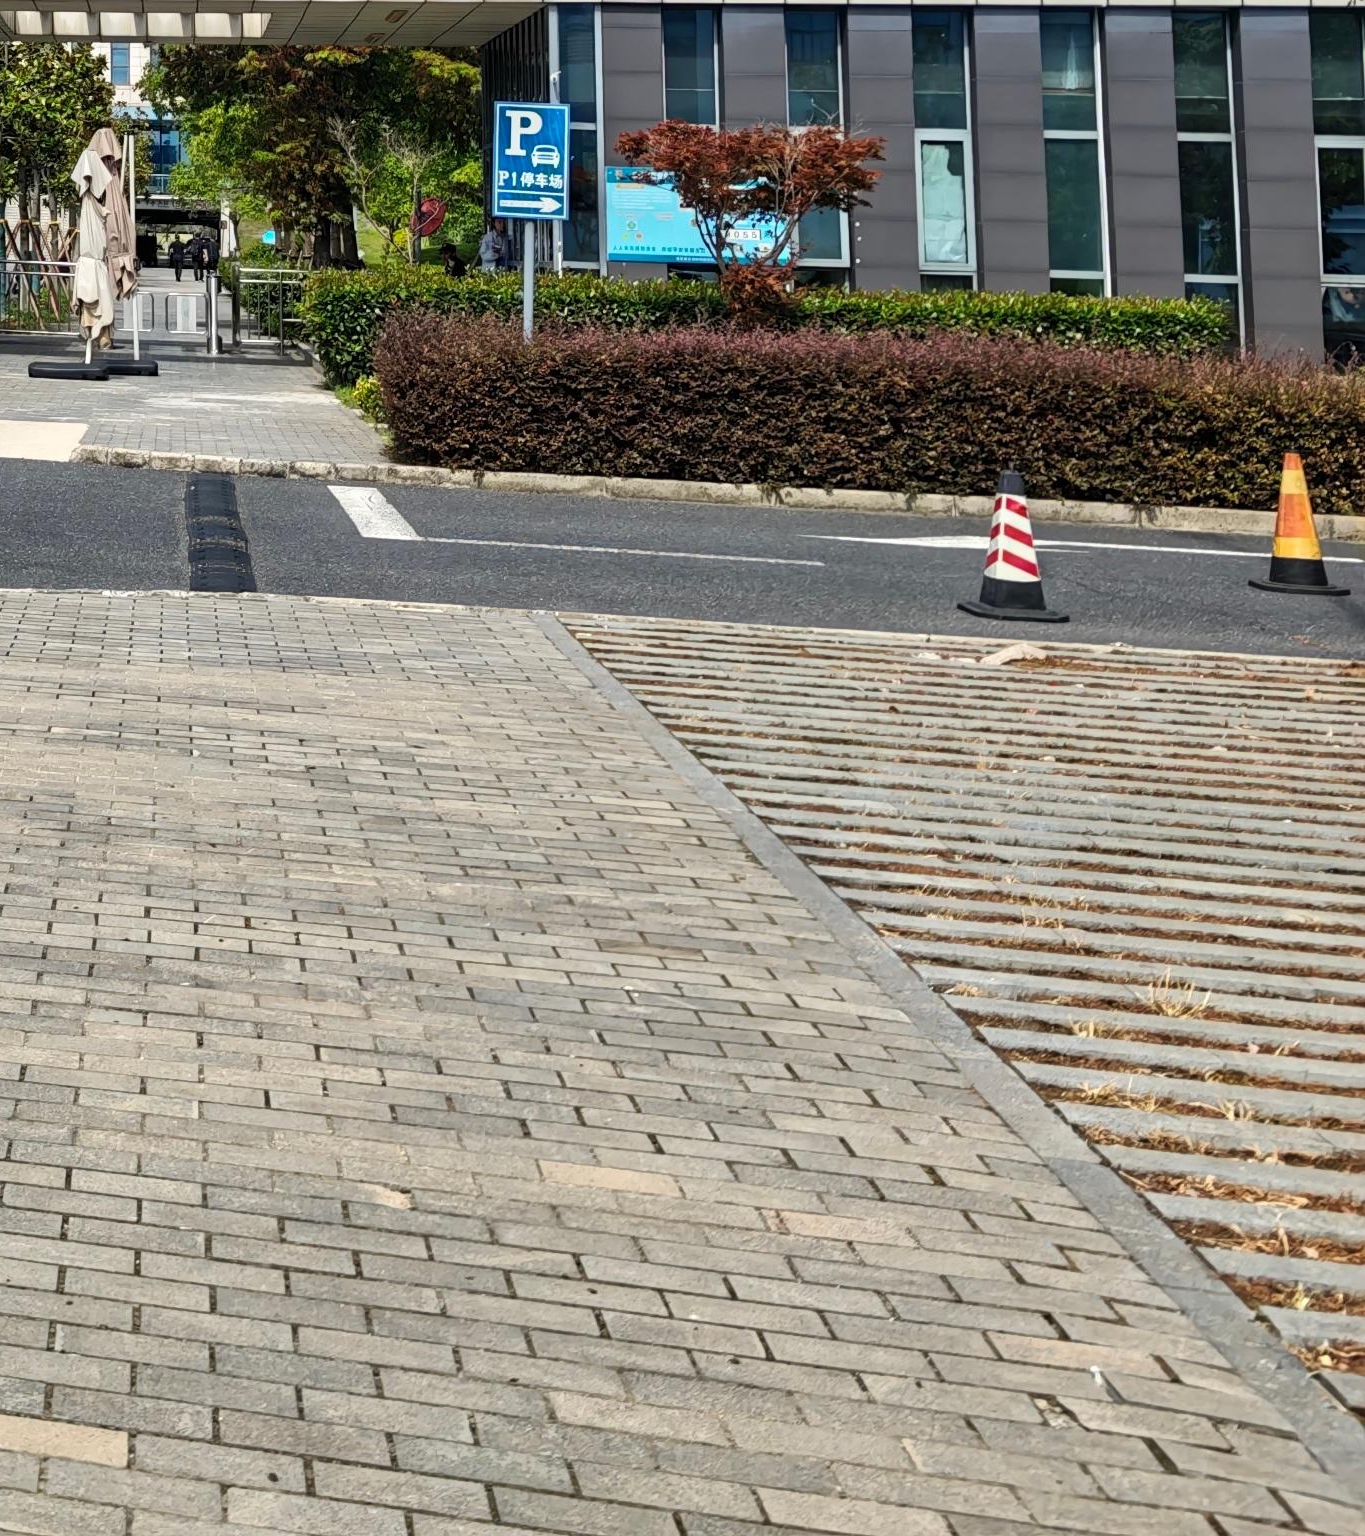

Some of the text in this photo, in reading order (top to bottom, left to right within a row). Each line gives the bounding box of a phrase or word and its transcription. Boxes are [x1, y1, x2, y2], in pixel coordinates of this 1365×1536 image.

[504, 110, 543, 156] P
[498, 170, 563, 190] P1停车场
